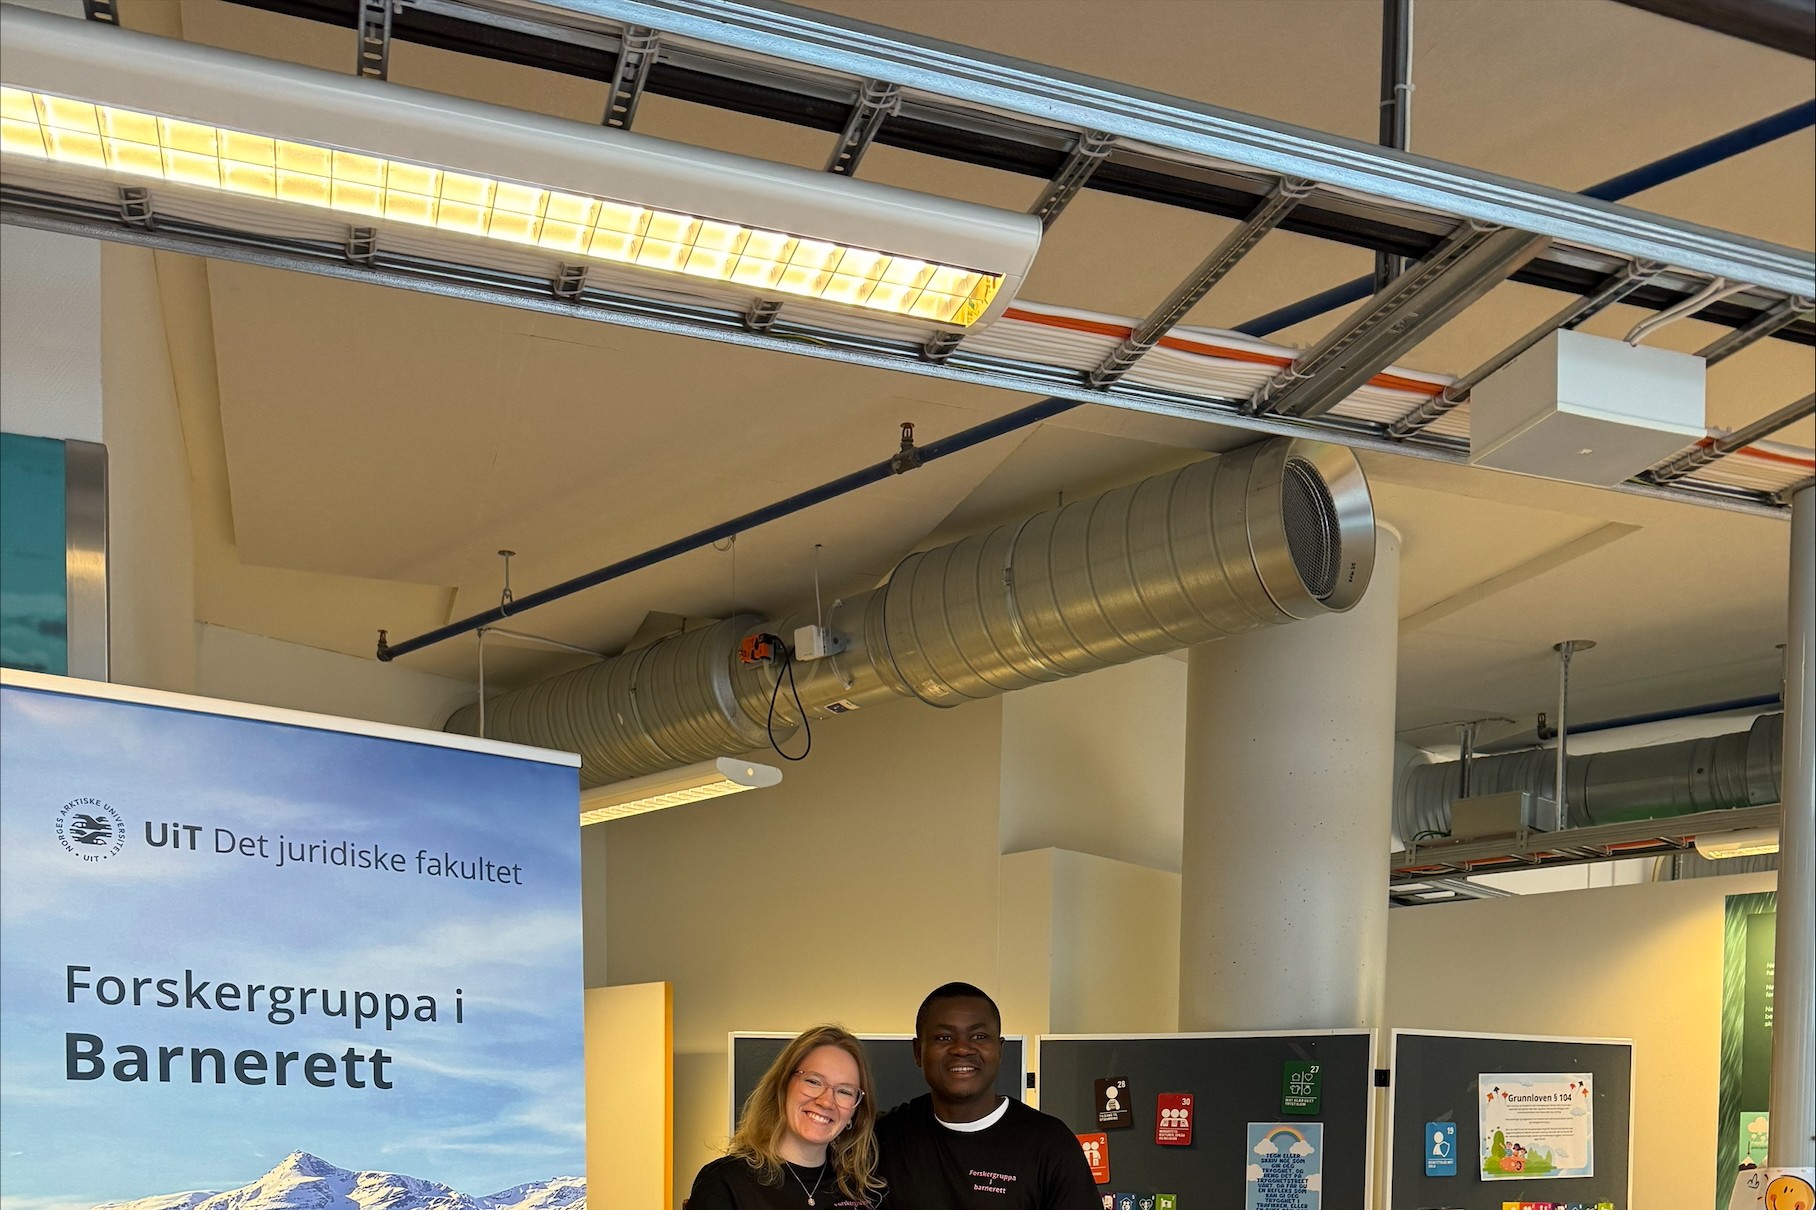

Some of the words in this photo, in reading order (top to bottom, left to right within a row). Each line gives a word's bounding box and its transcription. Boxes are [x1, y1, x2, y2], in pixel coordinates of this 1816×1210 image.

[60, 797, 102, 816] ARKTISKE
[56, 818, 74, 852] NORGES
[103, 803, 126, 856] UNIVERSITET
[145, 821, 202, 851] UiT
[214, 827, 269, 858] Det
[276, 834, 406, 872] juridiske
[415, 849, 523, 885] fakultet
[66, 965, 437, 1031] Forskergruppa
[455, 988, 464, 1024] i
[65, 1031, 393, 1090] Barnerett
[1310, 1065, 1320, 1074] 27
[1182, 1098, 1191, 1106] 30
[1508, 1093, 1552, 1102] Grunnloven
[1560, 1093, 1572, 1102] 104
[1446, 1127, 1454, 1135] 19
[969, 1170, 1016, 1181] Forskergruppa
[974, 1184, 1006, 1194] barnerett
